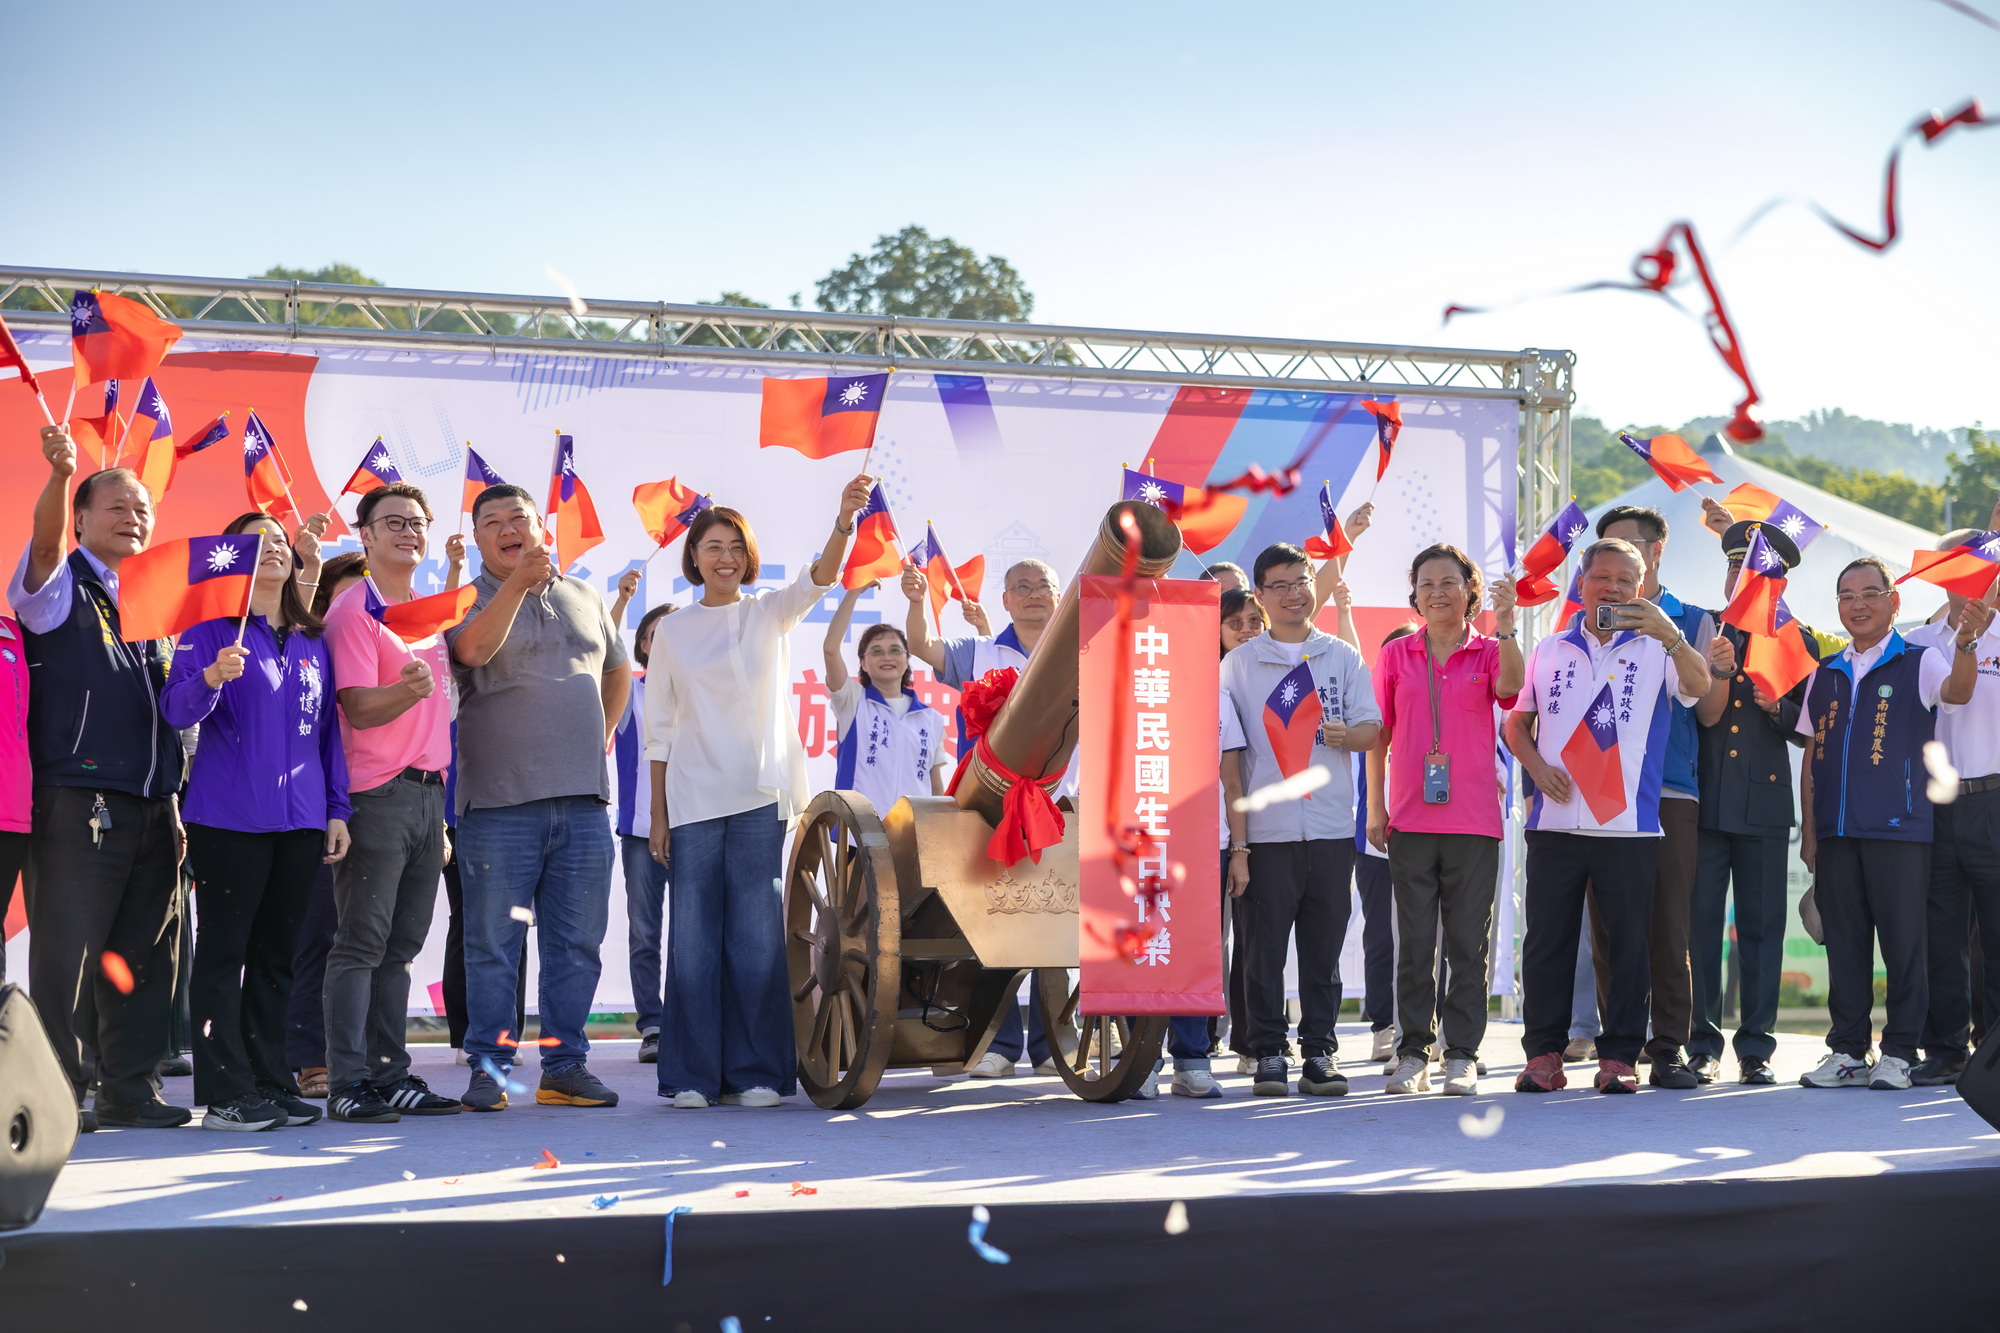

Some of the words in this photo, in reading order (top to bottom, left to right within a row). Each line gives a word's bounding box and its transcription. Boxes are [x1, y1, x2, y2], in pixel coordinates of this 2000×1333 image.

[298, 666, 316, 736] 林憶如
[1329, 676, 1341, 721] 南投縣議
[1547, 670, 1562, 715] 王瑞德
[1565, 660, 1577, 689] 副縣長
[1619, 662, 1638, 722] 南投縣政府
[917, 728, 928, 782] 南投縣政府
[1869, 699, 1889, 766] 南投縣農會
[1133, 626, 1171, 967] 中華民國生日快樂
